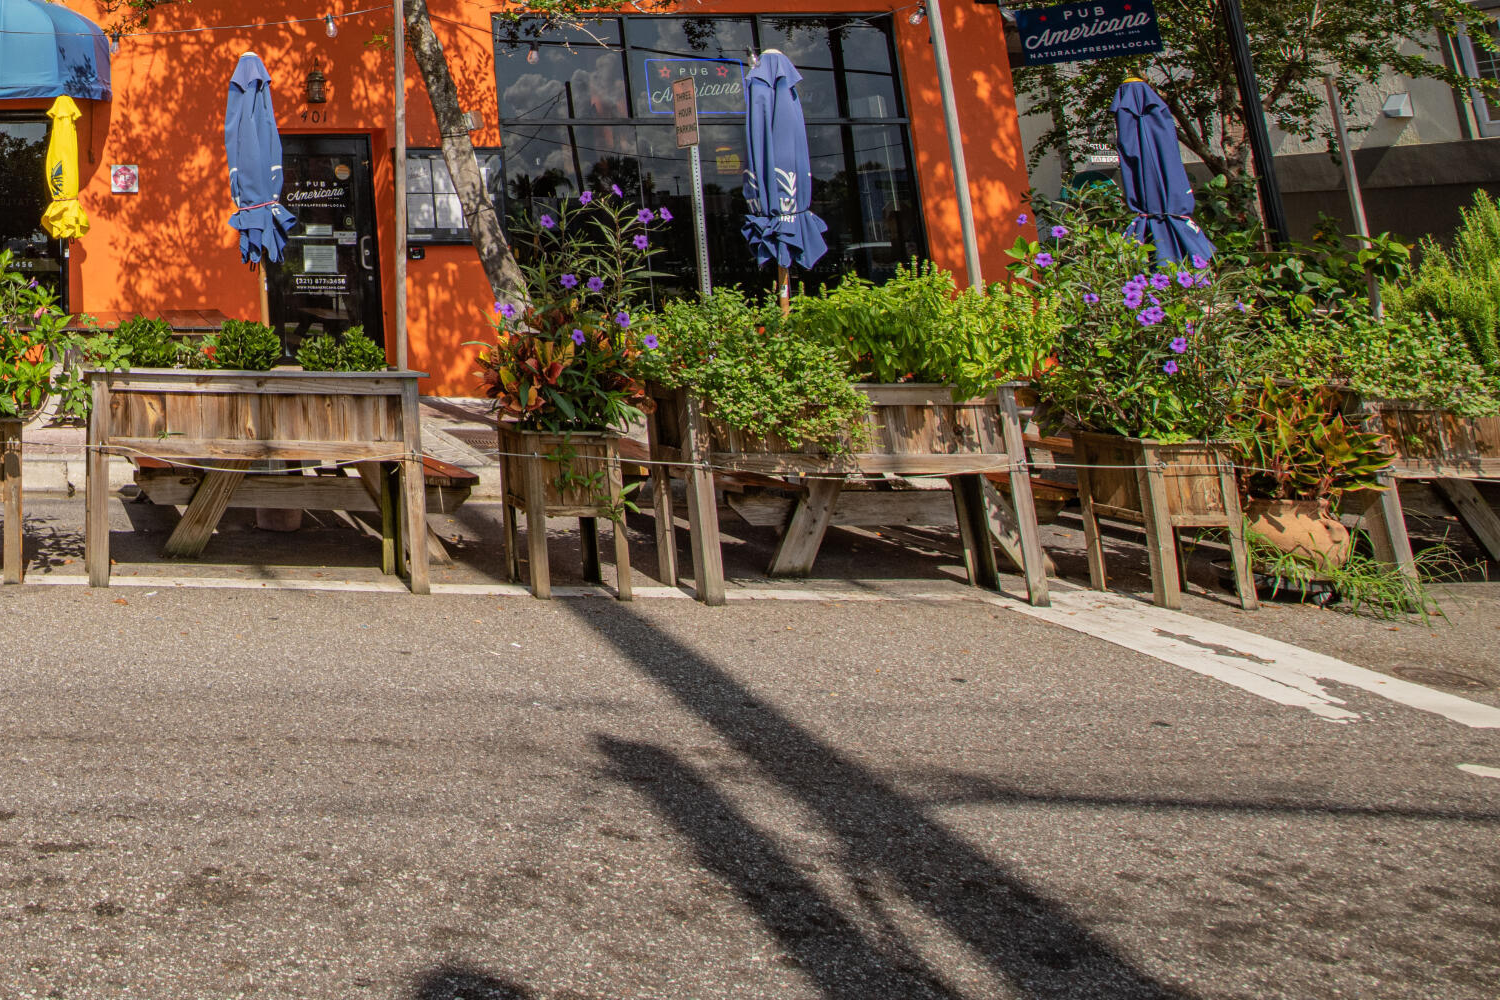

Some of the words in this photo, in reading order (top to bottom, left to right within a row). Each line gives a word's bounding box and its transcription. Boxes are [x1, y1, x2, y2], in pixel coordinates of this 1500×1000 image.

[1063, 6, 1105, 20] PUB
[1025, 12, 1151, 50] Americana
[679, 67, 709, 76] PUB
[676, 91, 692, 102] THREE
[300, 110, 328, 124] 401
[678, 107, 692, 118] HOUR
[676, 122, 697, 135] PARKING
[286, 187, 345, 202] Americana
